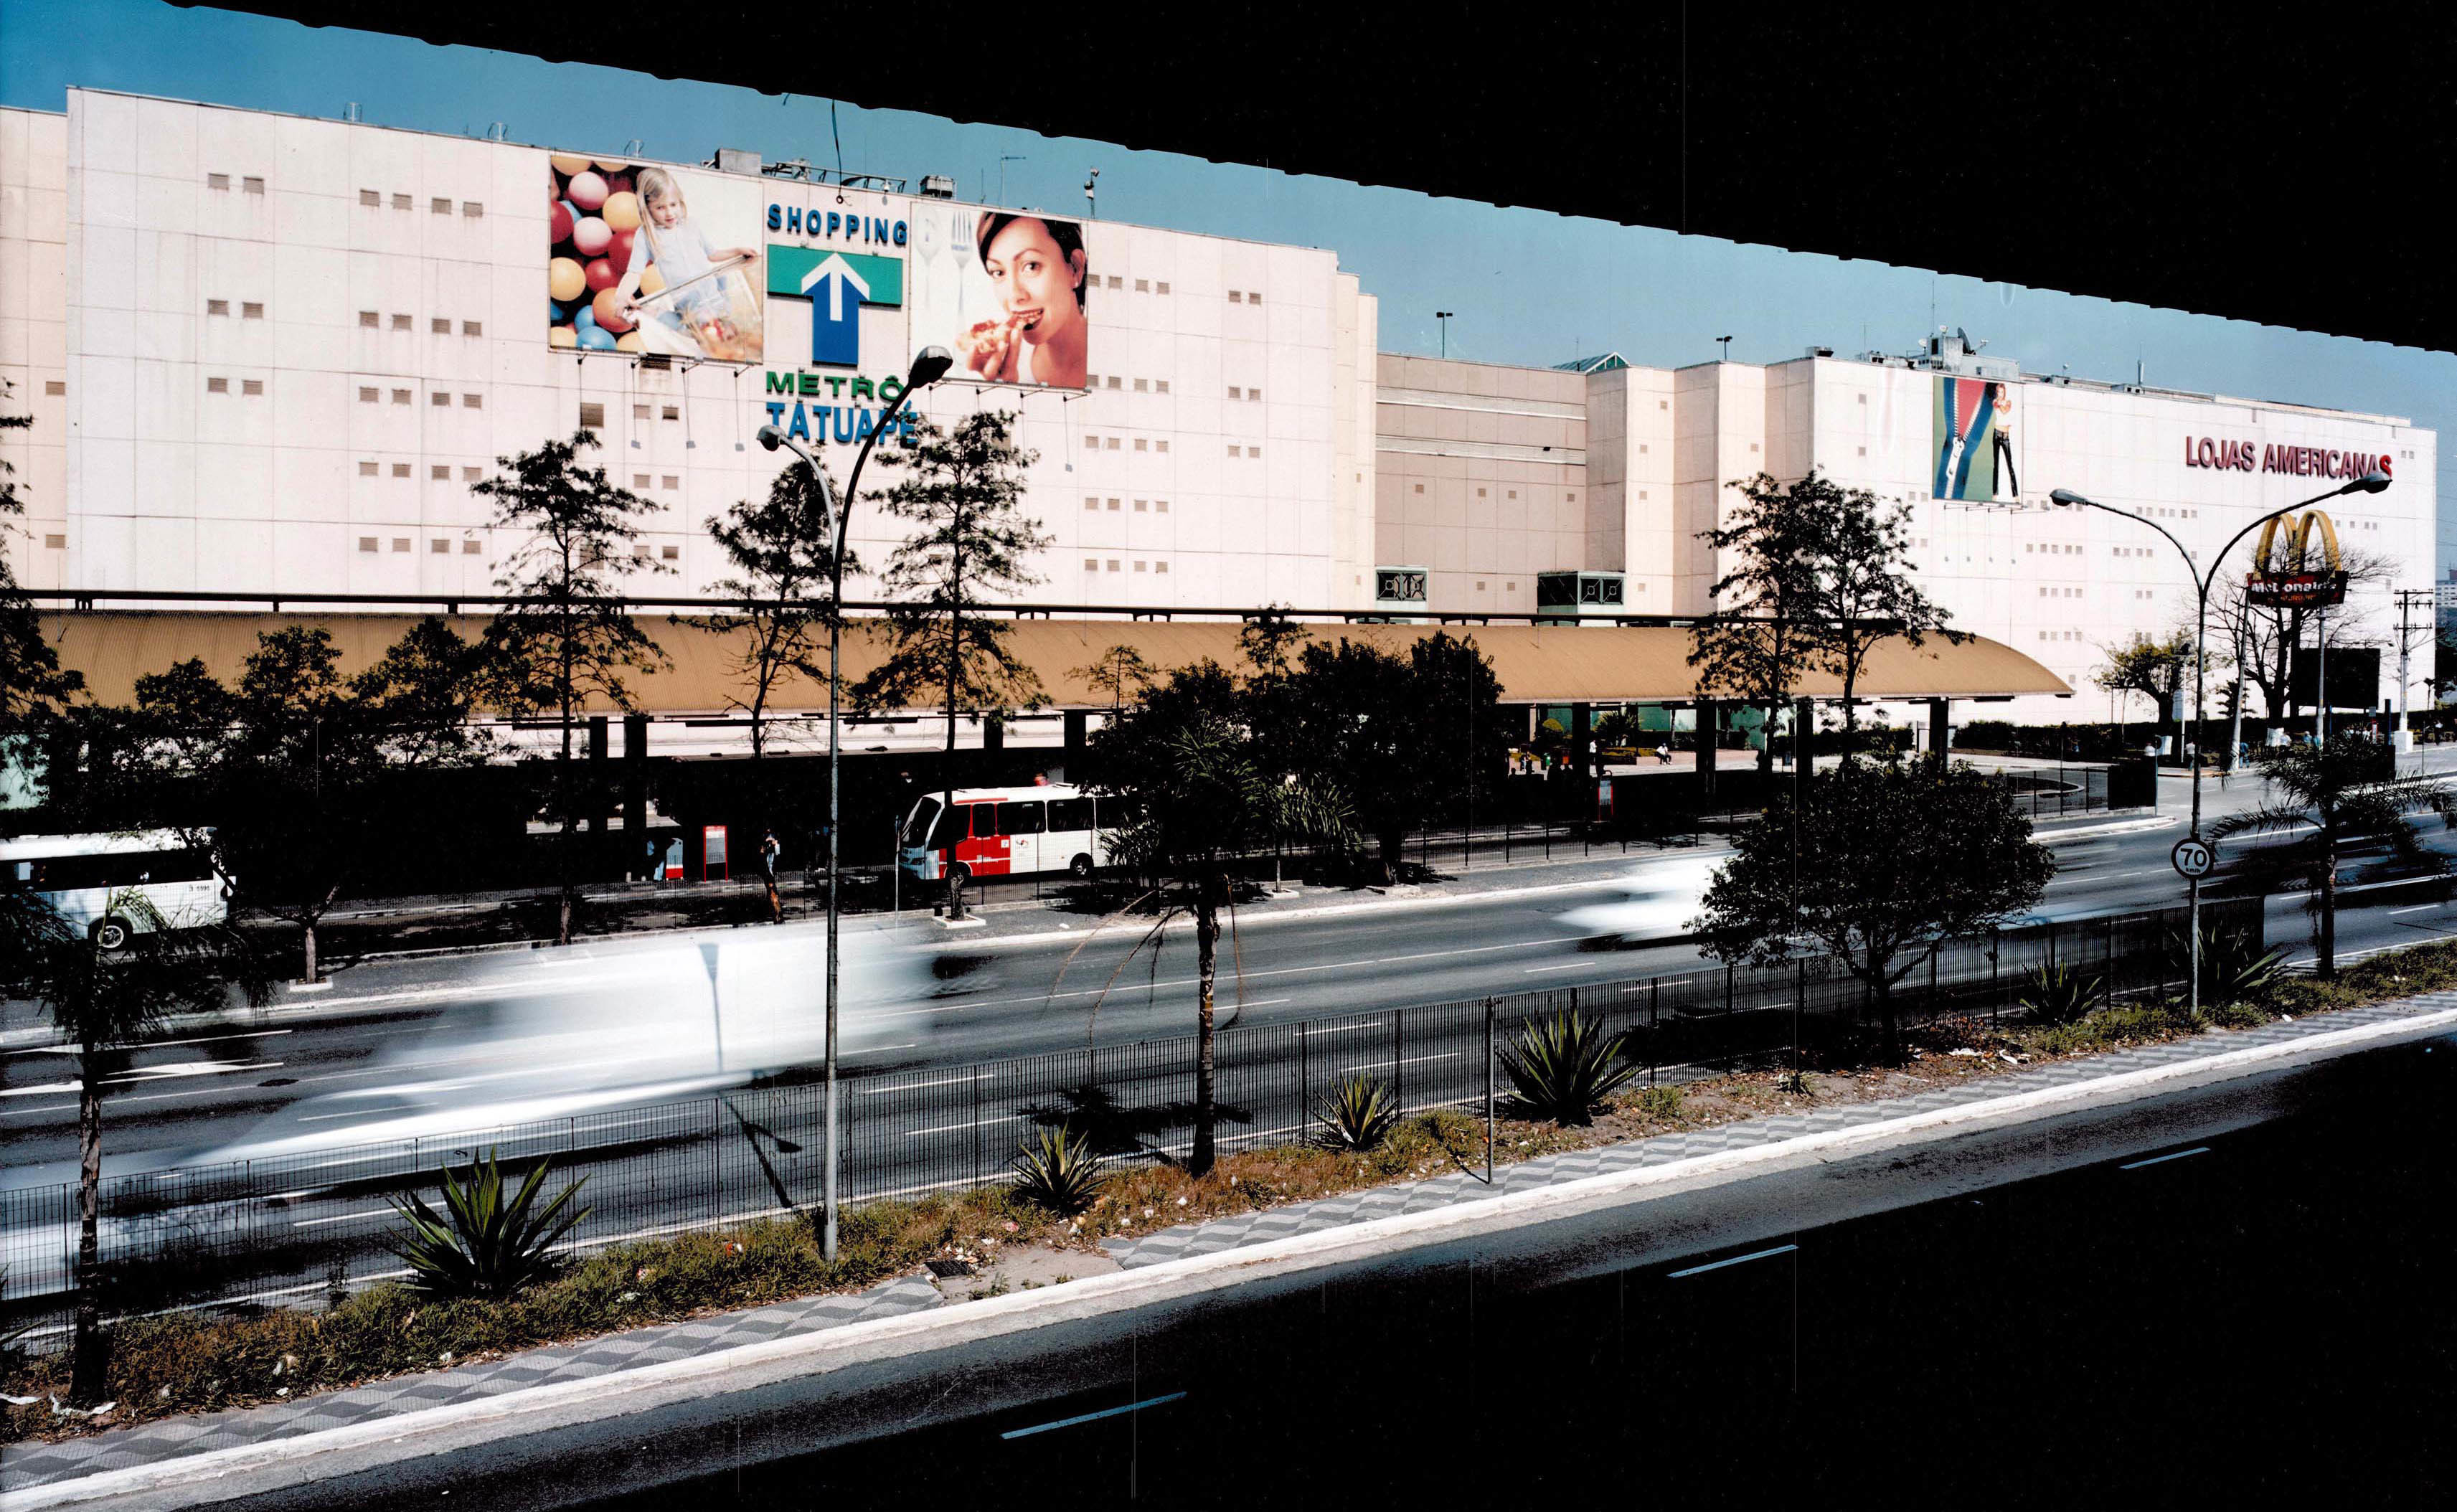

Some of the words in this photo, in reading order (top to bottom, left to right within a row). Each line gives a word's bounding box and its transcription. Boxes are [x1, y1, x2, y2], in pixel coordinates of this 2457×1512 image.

[767, 203, 907, 246] SHOPPING
[765, 371, 905, 402] METRÔ
[765, 399, 919, 448] TATUAPÉ
[2186, 435, 2256, 472] LOJAS
[2262, 443, 2392, 480] AMERICANAS
[2250, 580, 2337, 593] McDonal
[2180, 848, 2207, 867] 70
